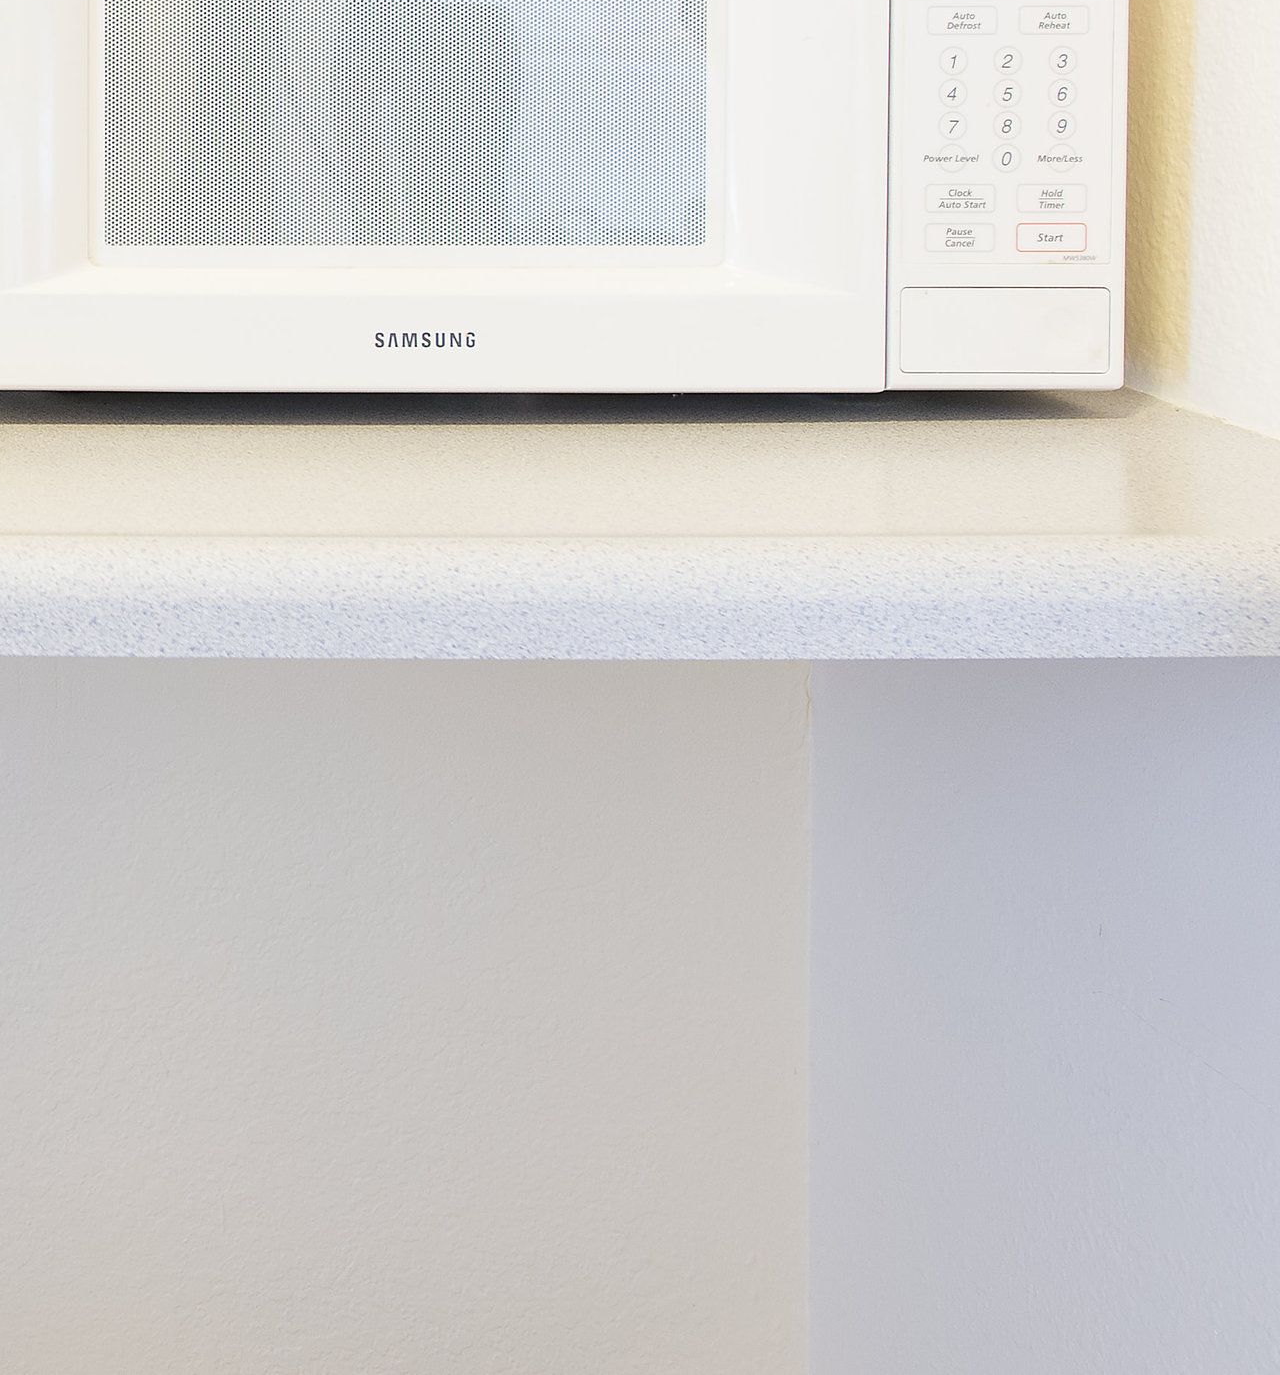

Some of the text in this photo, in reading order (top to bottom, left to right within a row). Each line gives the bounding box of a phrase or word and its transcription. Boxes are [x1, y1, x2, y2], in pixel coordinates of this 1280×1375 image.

[952, 12, 976, 20] Auto
[1043, 12, 1067, 20] Auto
[947, 22, 981, 30] Defrost
[1038, 22, 1071, 30] Reheat
[950, 55, 958, 69] 1
[1002, 54, 1014, 69] 2
[1057, 54, 1068, 69] 3
[947, 87, 957, 101] 4
[1002, 87, 1013, 102] 5
[1057, 86, 1068, 102] 6
[948, 120, 959, 134] 7
[1001, 119, 1013, 134] 8
[1056, 119, 1068, 134] 9
[923, 154, 979, 163] Power Level
[1001, 151, 1012, 166] 0
[1037, 154, 1083, 163] More/Less
[948, 189, 973, 197] Clock
[1041, 189, 1063, 198] Hold
[939, 201, 986, 209] Auto Start
[1038, 201, 1065, 209] Timer
[945, 228, 973, 236] Pause
[1037, 233, 1063, 243] Start
[944, 239, 975, 248] Cancel
[374, 331, 476, 348] SAMSUNG
